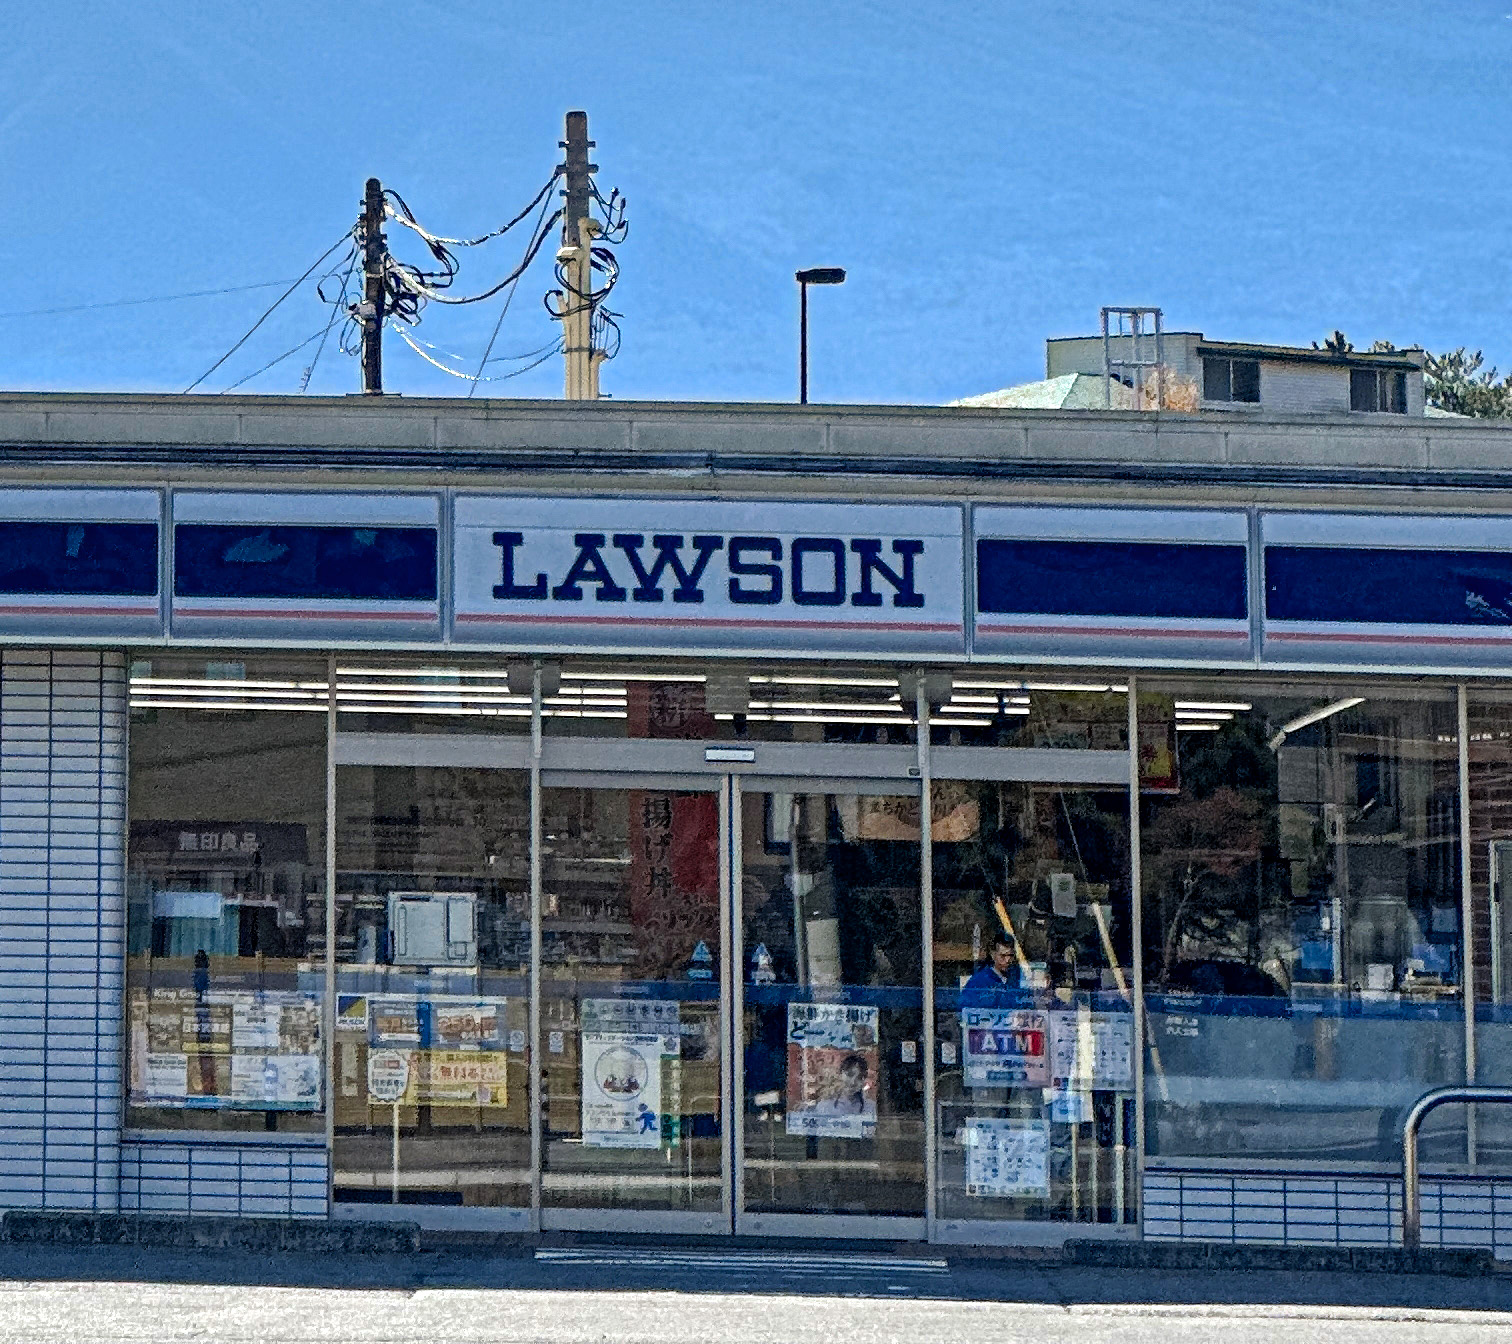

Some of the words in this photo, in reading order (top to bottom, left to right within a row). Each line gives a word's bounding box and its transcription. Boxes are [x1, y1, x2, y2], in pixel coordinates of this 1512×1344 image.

[492, 531, 924, 608] LAWSON
[178, 831, 259, 852] 無印良品
[981, 1033, 1034, 1052] ATM
